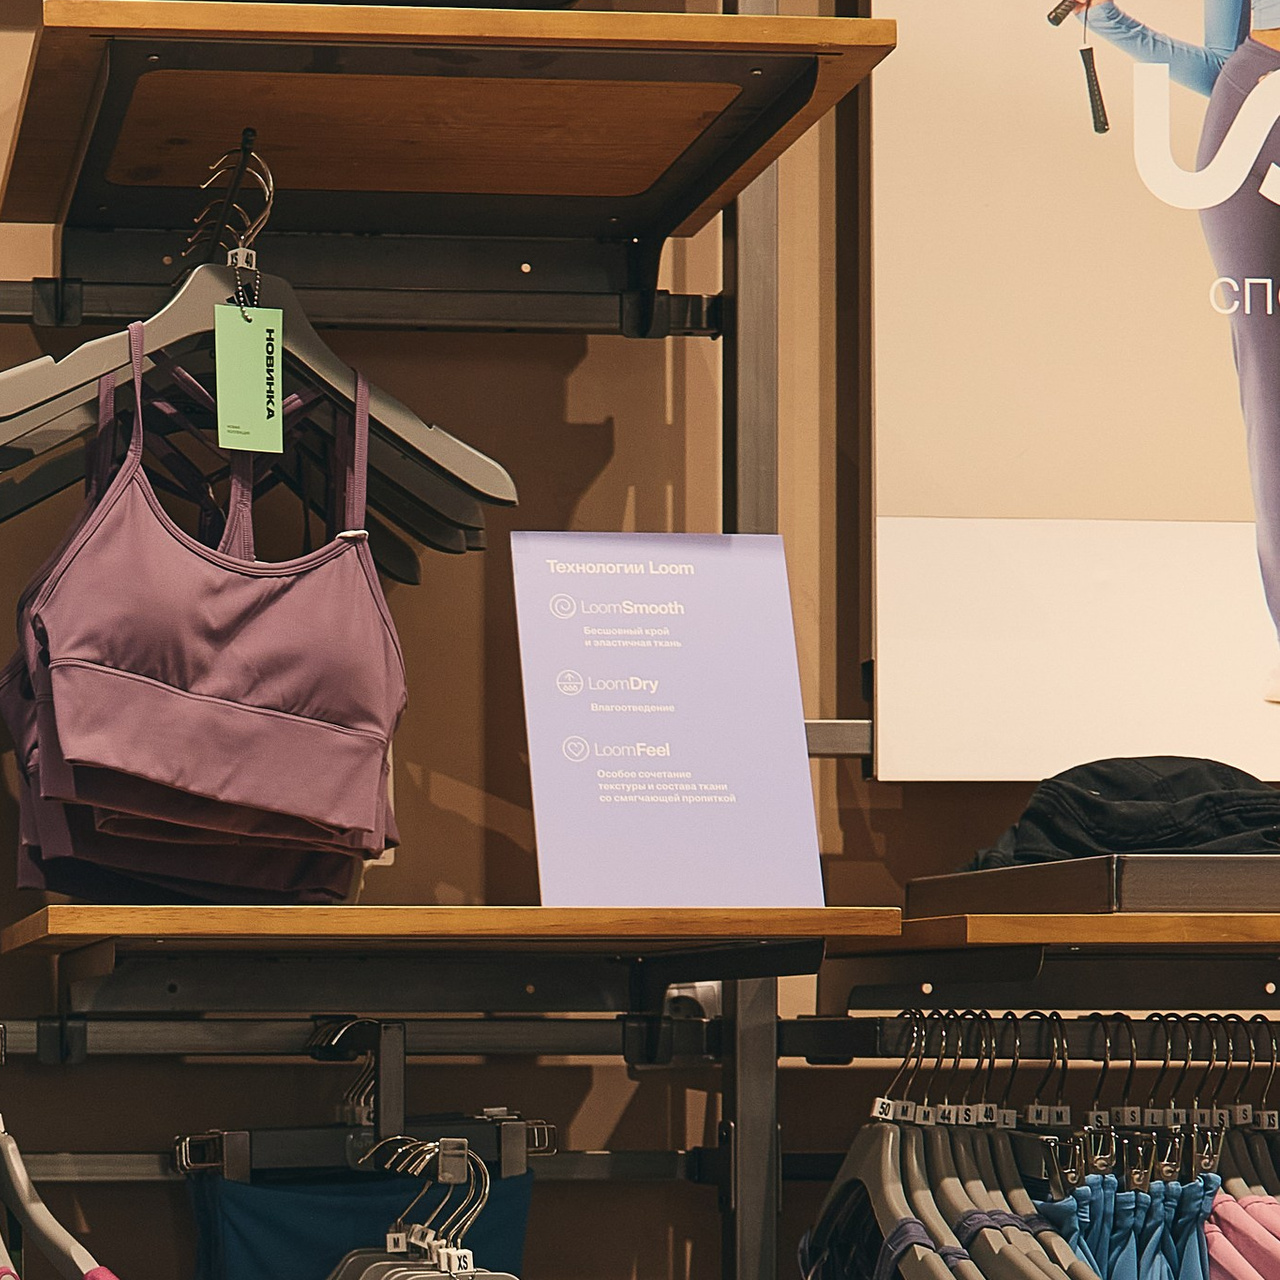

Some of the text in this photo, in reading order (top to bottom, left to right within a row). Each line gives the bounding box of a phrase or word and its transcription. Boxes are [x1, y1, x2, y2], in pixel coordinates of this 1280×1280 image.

[265, 328, 275, 420] НОВИНКА
[546, 559, 695, 575] Технологии Loom
[581, 600, 685, 615] LoomSmooth
[583, 626, 670, 637] Бесшовный крой
[593, 639, 652, 647] эластичная
[654, 640, 682, 648] ткань
[588, 676, 659, 694] LoomDry
[590, 703, 675, 713] Влагоотведение
[594, 742, 670, 757] LoomFeel
[596, 769, 692, 779] Особое сочетание
[598, 783, 646, 792] текстуры
[656, 783, 697, 791] состава
[699, 783, 728, 791] ткани
[614, 793, 681, 803] смягчающей
[682, 794, 737, 804] пропиткой
[879, 1103, 890, 1116] 50
[940, 1109, 951, 1122] 44
[964, 1108, 970, 1122] S
[984, 1106, 993, 1121] 40
[1130, 1110, 1136, 1122] S
[1243, 1109, 1248, 1120] S
[1003, 1114, 1008, 1125] L
[1095, 1115, 1103, 1128] S
[1151, 1113, 1157, 1124] L
[1218, 1113, 1225, 1126] S
[457, 1255, 468, 1270] XS
